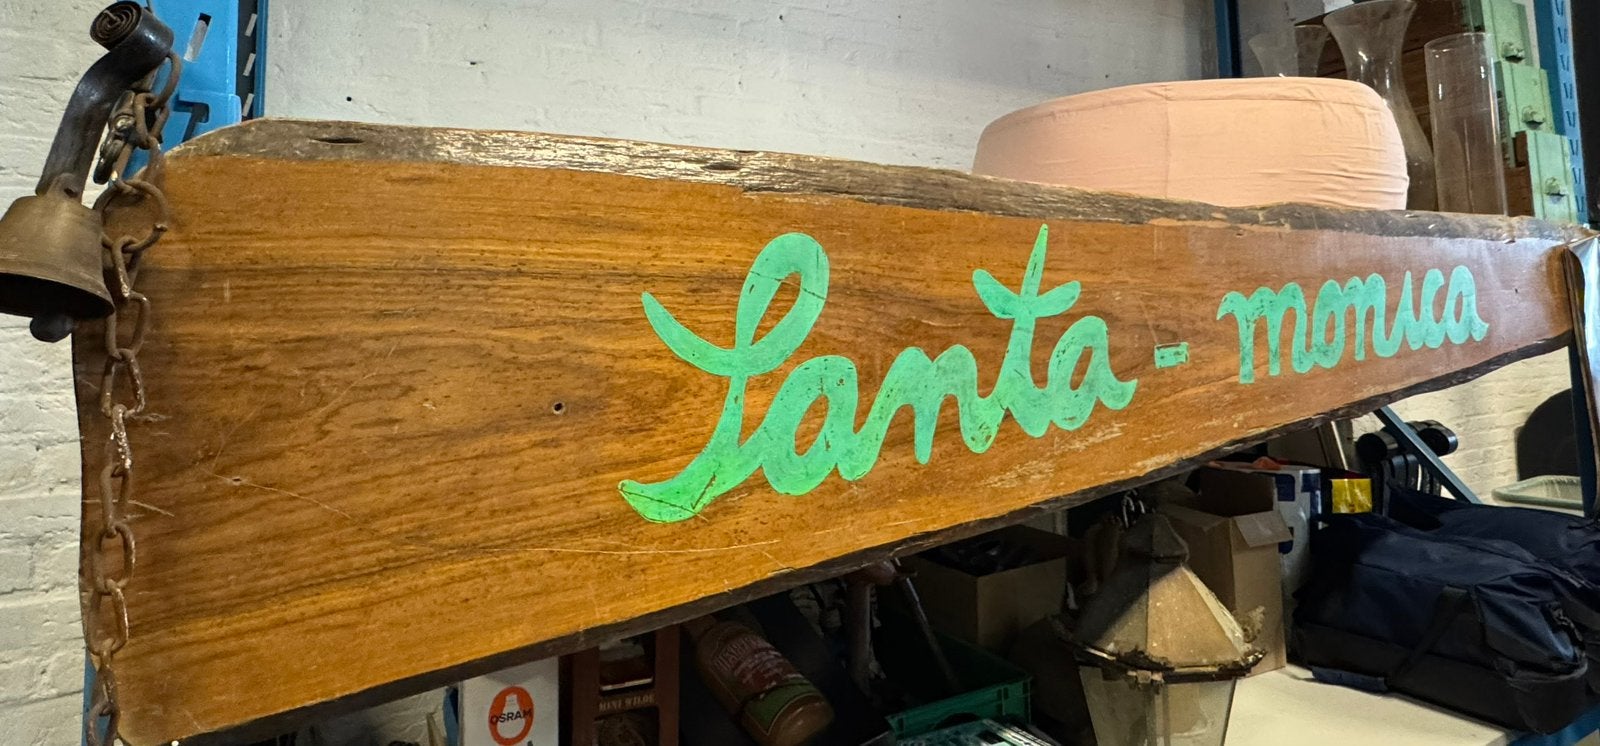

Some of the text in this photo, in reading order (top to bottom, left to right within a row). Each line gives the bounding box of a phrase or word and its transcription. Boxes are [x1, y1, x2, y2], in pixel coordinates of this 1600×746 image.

[618, 223, 1137, 523] Santa
[1217, 265, 1489, 384] monica
[489, 708, 533, 725] OSRAM
